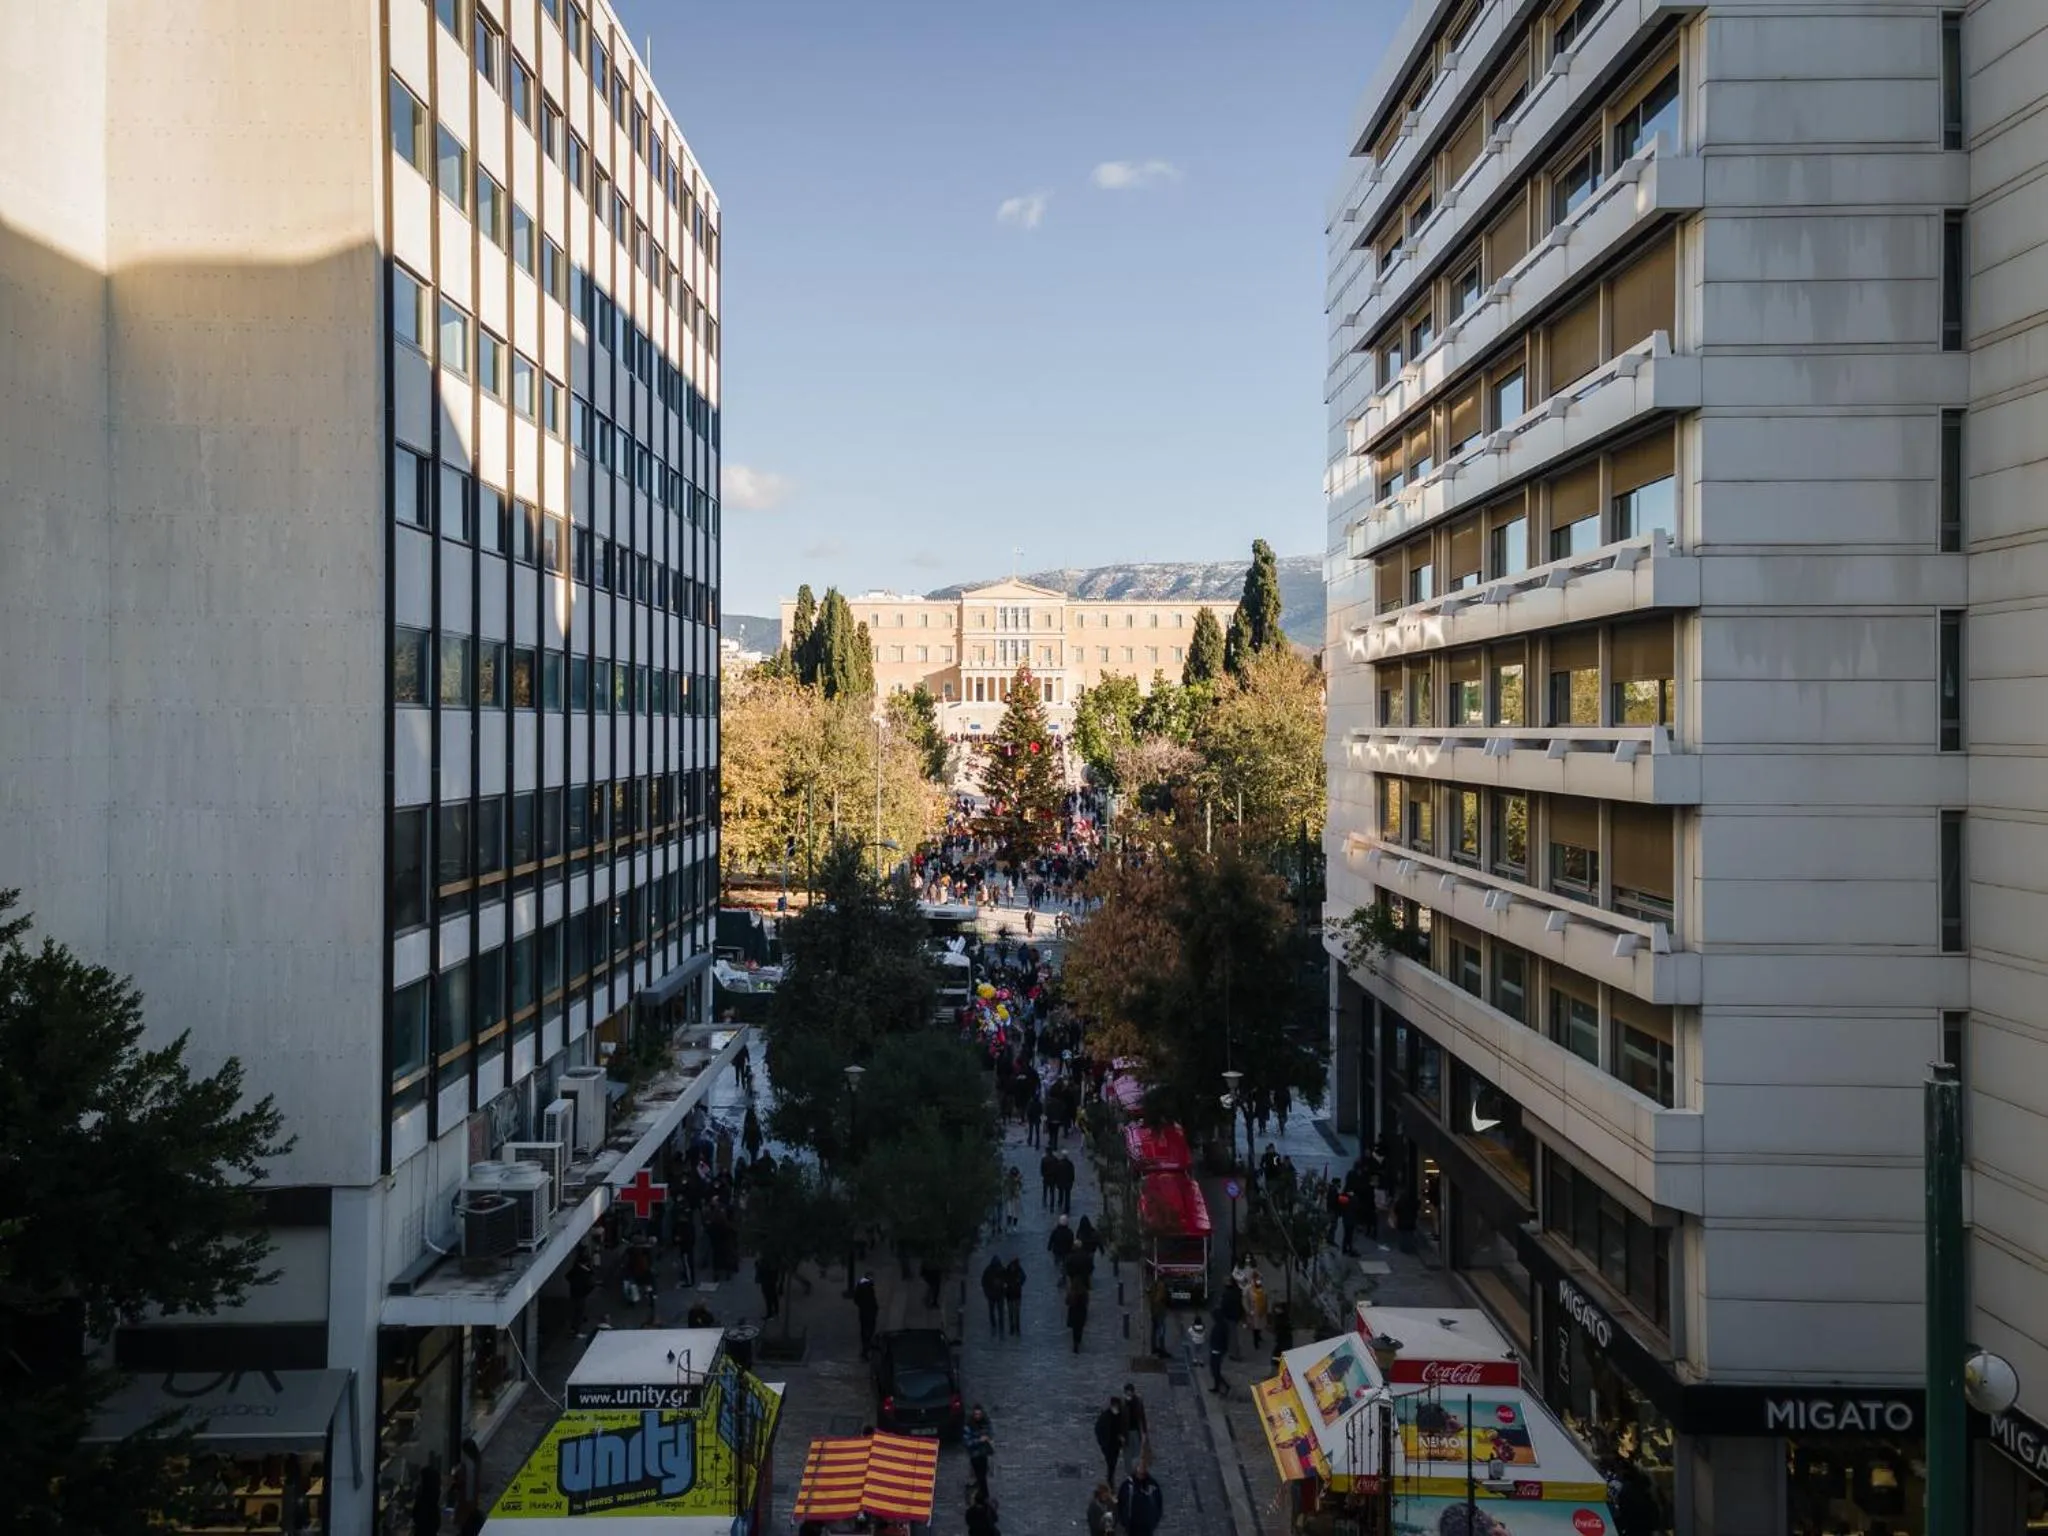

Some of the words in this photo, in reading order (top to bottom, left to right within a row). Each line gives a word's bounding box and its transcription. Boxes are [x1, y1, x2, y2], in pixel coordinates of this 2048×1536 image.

[1559, 1279, 1612, 1348] MIGATO
[1421, 1361, 1485, 1384] Coca-Cola
[579, 1384, 693, 1407] www.unity.gr
[1765, 1398, 1914, 1432] MIGATO
[562, 1410, 693, 1496] unity
